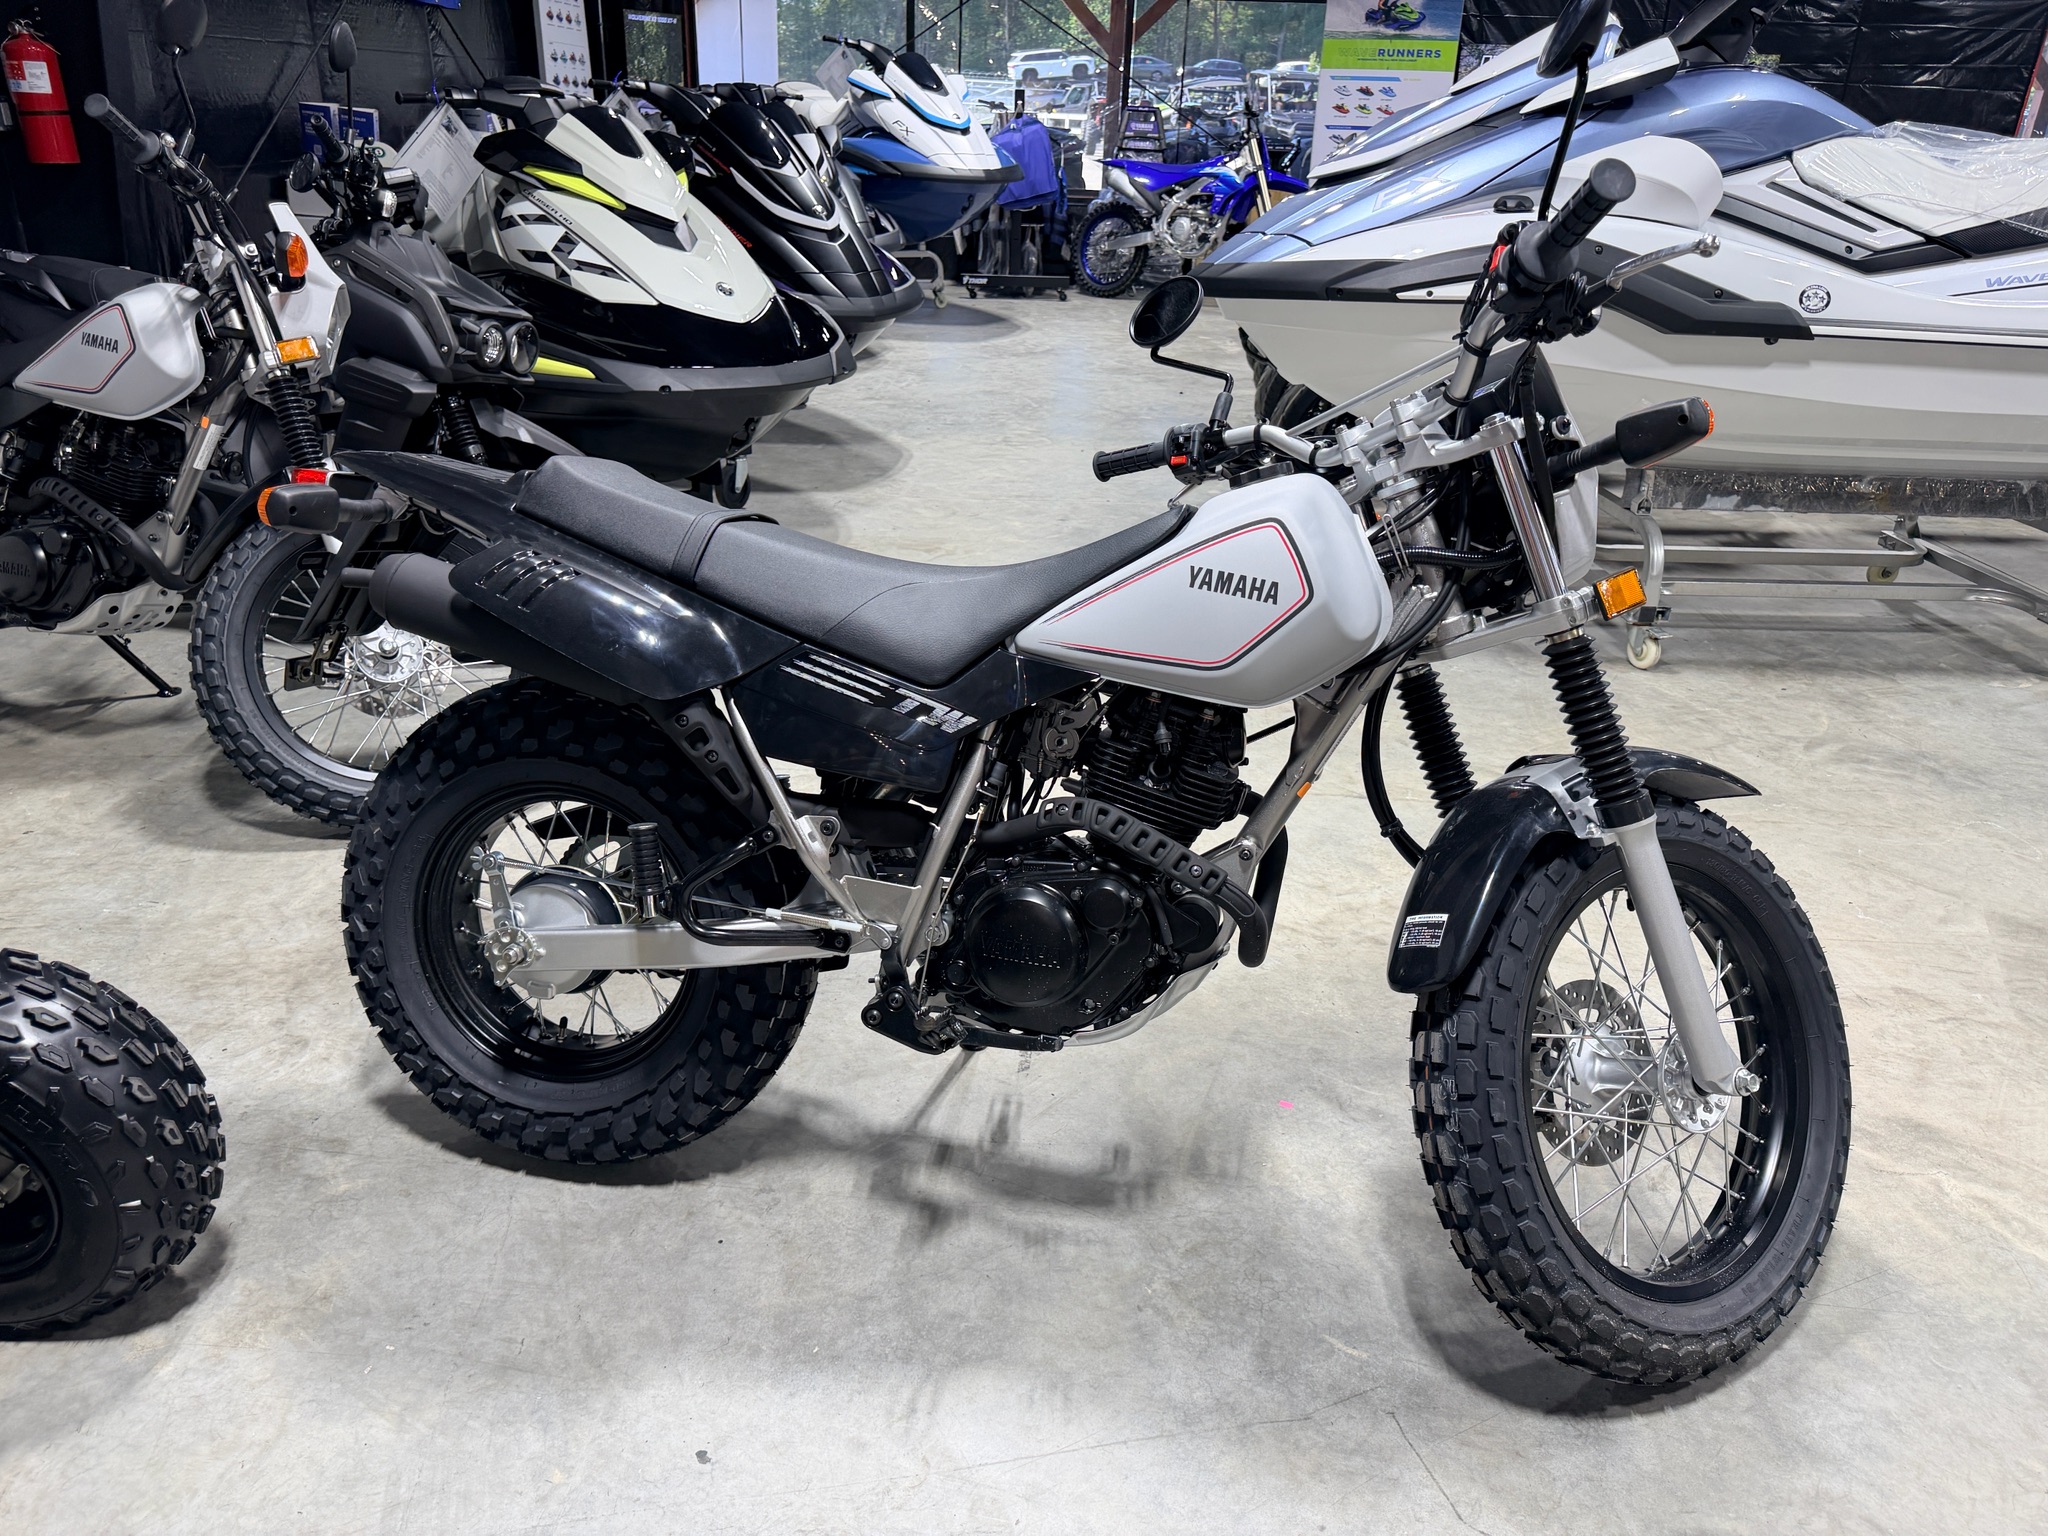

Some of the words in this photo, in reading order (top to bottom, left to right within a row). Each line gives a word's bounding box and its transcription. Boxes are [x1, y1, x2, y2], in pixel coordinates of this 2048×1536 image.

[892, 119, 915, 137] FX
[80, 331, 119, 354] YAMAHA
[1188, 564, 1280, 606] YAMAHA
